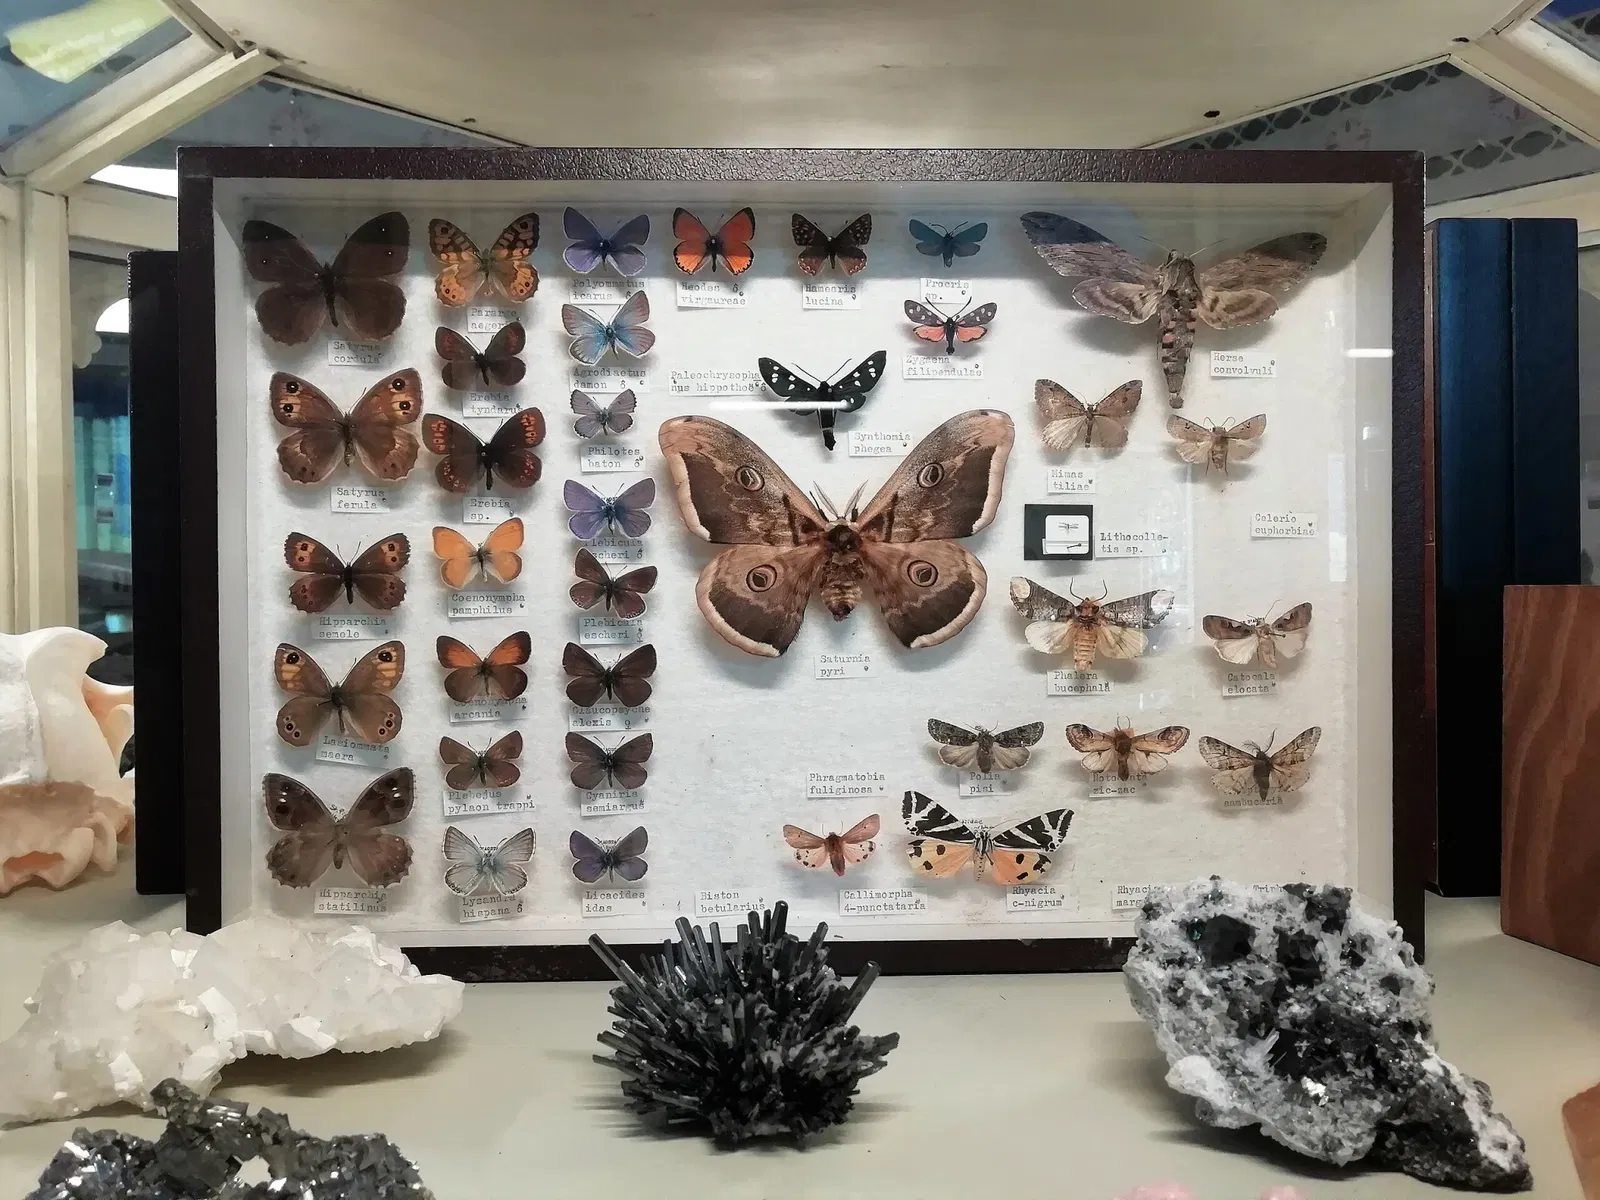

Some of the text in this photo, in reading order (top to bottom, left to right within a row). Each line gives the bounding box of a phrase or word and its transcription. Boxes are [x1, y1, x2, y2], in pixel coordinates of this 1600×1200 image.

[680, 281, 720, 291] Heodes
[804, 283, 857, 294] Hamearis
[924, 279, 970, 290] Procris
[572, 292, 613, 301] icarus
[804, 296, 845, 306] lucina
[333, 354, 381, 364] cordula
[905, 355, 951, 367] Zygaena
[1213, 352, 1244, 362] Herse
[1213, 364, 1273, 376] convolvuli
[573, 380, 608, 390] damon
[670, 384, 690, 393] nus
[854, 432, 911, 444] Synthomia
[587, 446, 641, 457] Philotes
[854, 444, 893, 456] phegea
[587, 458, 622, 469] baton
[1051, 469, 1084, 480] Mimas
[1051, 481, 1090, 491] tiliae
[336, 486, 385, 499] Satyrus
[336, 499, 378, 510] ferula
[470, 497, 511, 508] Erebia
[470, 512, 490, 522] sp.
[1254, 525, 1316, 537] euphorbiae
[1100, 544, 1145, 556] tis sp.
[451, 592, 526, 605] Coenonympha
[451, 604, 514, 617] pamphilus
[318, 615, 387, 629] Hipparchia
[583, 630, 630, 640] escheri
[819, 653, 871, 664] Saturnia
[819, 666, 846, 678] pyri
[1053, 670, 1099, 681] Phalera
[1227, 671, 1276, 683] Catocala
[1227, 684, 1270, 694] elocata
[453, 709, 501, 720] arcania
[571, 718, 612, 729] alexis
[320, 748, 355, 762] maera
[808, 771, 886, 784] Phragmatobia
[969, 771, 1002, 782] Polia
[447, 789, 503, 802] Plebejus
[584, 788, 639, 803] Cyaniris
[808, 784, 874, 797] fuliginosa
[1091, 785, 1137, 796] zic-zac
[447, 798, 536, 815] pylaon trappi
[699, 890, 740, 901] Biston
[842, 889, 914, 902] Callimorpha
[1011, 885, 1056, 898] Rhyacia
[1116, 884, 1158, 897] Rhyaci
[317, 901, 387, 914] statilinus
[584, 902, 613, 914] idas
[699, 901, 767, 915] betularius
[1011, 897, 1063, 910] c-nigrum
[461, 905, 511, 920] hispana
